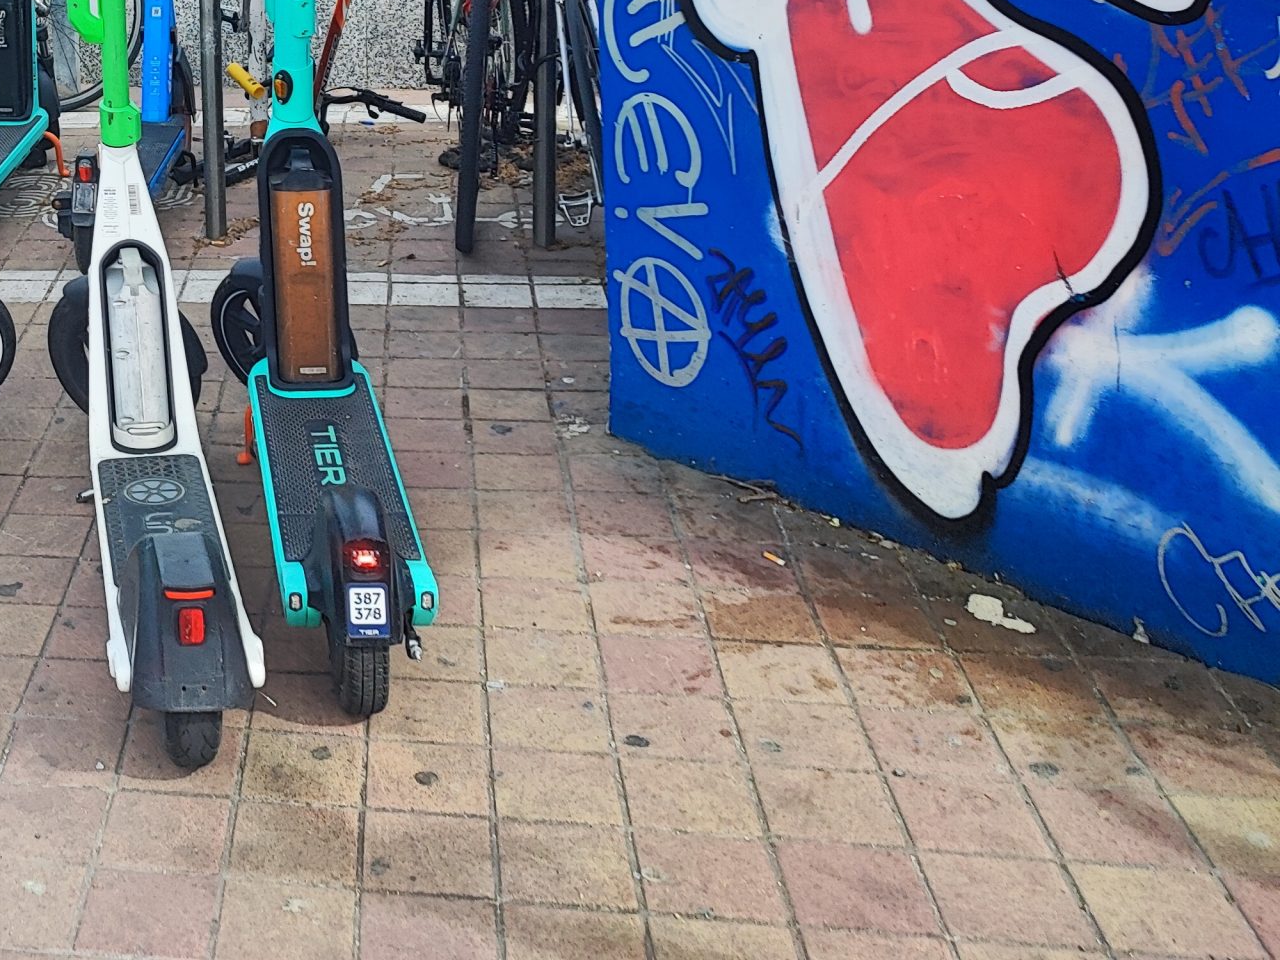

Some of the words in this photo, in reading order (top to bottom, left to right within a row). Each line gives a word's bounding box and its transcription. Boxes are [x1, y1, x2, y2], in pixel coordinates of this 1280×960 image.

[295, 201, 317, 268] Swap!
[310, 424, 348, 487] TIER
[353, 591, 381, 606] 387
[353, 606, 383, 621] 378
